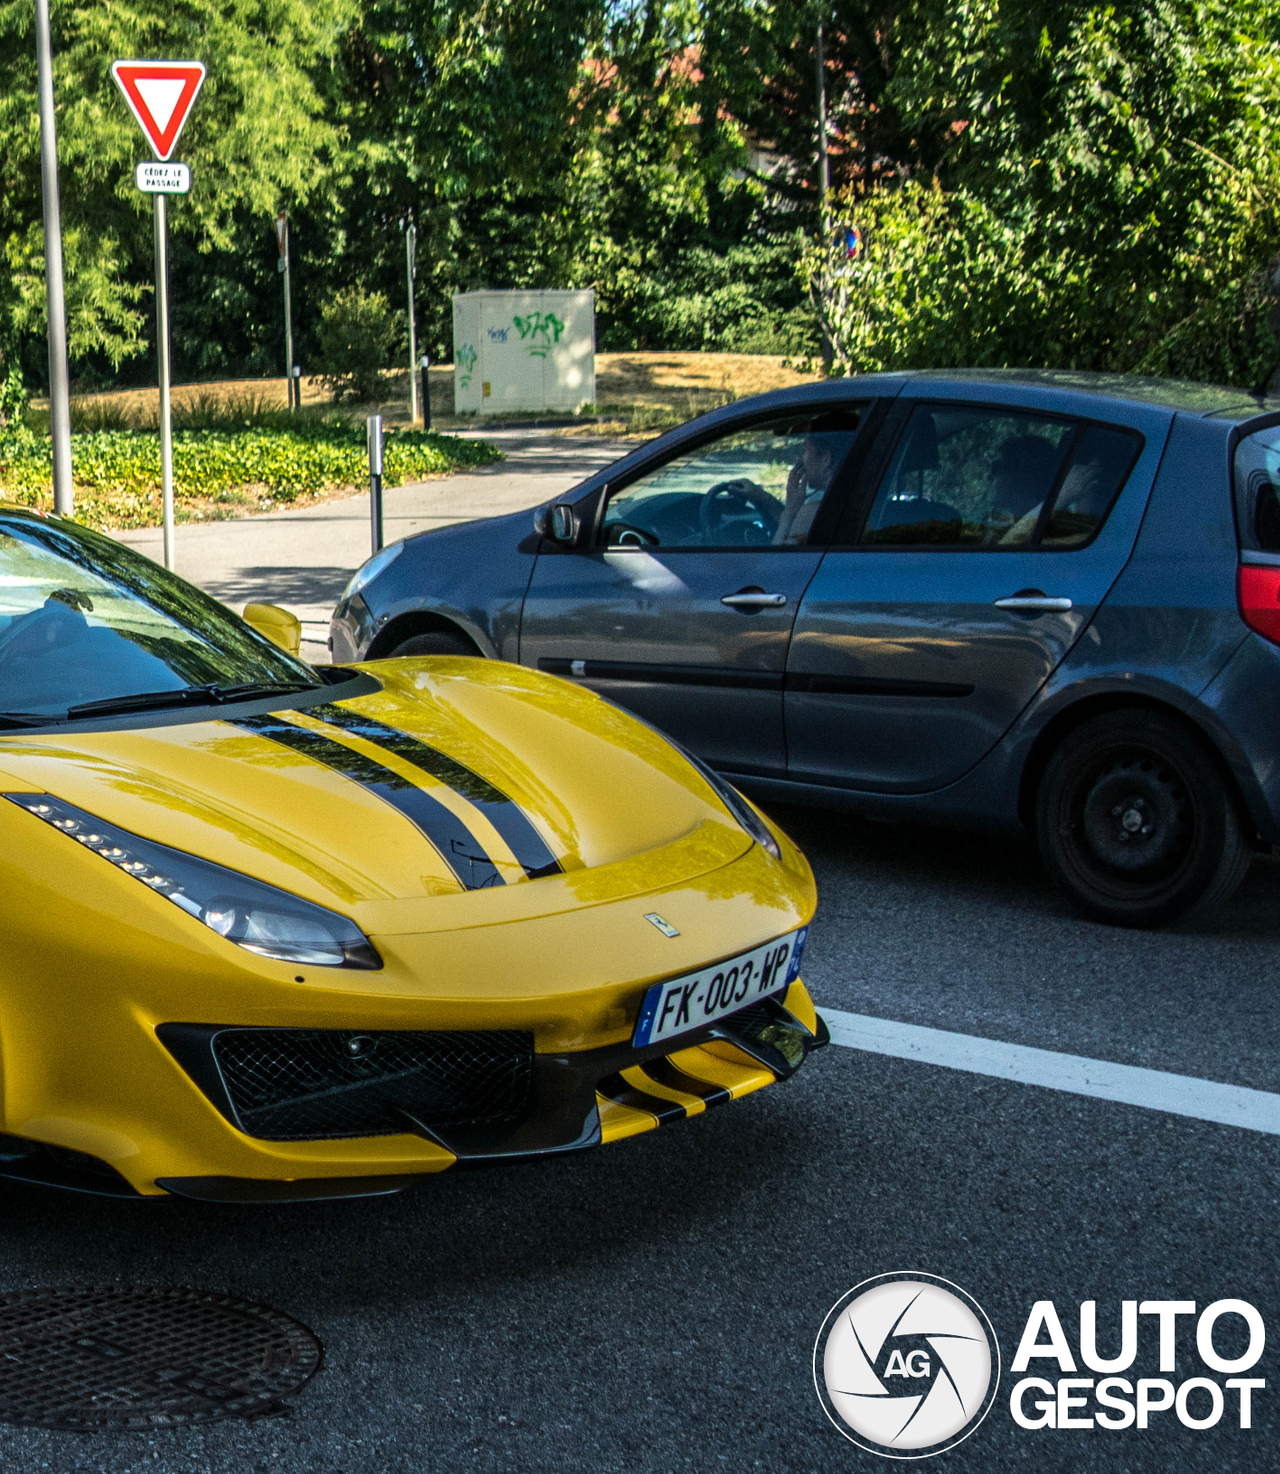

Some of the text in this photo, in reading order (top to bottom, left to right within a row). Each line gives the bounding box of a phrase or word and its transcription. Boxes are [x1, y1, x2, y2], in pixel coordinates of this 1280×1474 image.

[173, 169, 182, 177] LE
[146, 179, 180, 187] PASSAGE
[657, 943, 789, 1033] FK-003-WP
